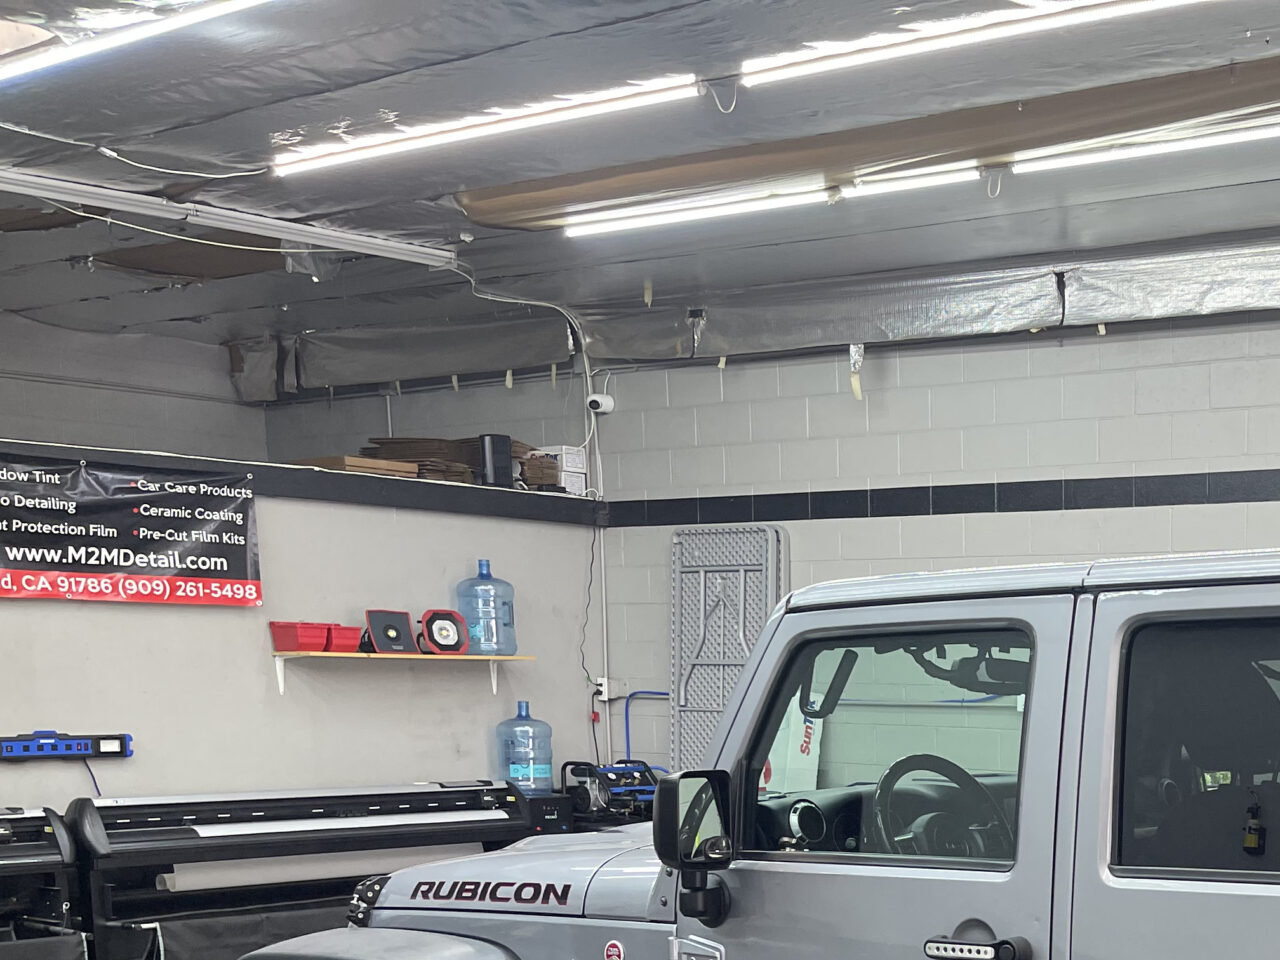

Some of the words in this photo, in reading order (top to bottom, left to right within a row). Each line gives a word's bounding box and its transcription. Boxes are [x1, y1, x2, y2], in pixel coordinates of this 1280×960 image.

[32, 471, 61, 484] Tint
[137, 480, 160, 491] Car
[164, 482, 197, 494] Care
[200, 483, 253, 498] Products
[14, 495, 77, 514] Detailing
[140, 504, 192, 519] Ceramic
[194, 508, 243, 525] Coating
[12, 520, 86, 535] Protection
[89, 524, 118, 538] Film
[139, 528, 188, 541] Pre-Cut
[191, 531, 220, 543] Film
[222, 532, 246, 545] Kits
[5, 546, 228, 571] www.M2MDetail.com
[21, 575, 52, 591] CA
[57, 576, 113, 593] 91786
[118, 578, 170, 600] (909)
[175, 581, 257, 599] 261-5498
[410, 881, 572, 906] RUBICON
